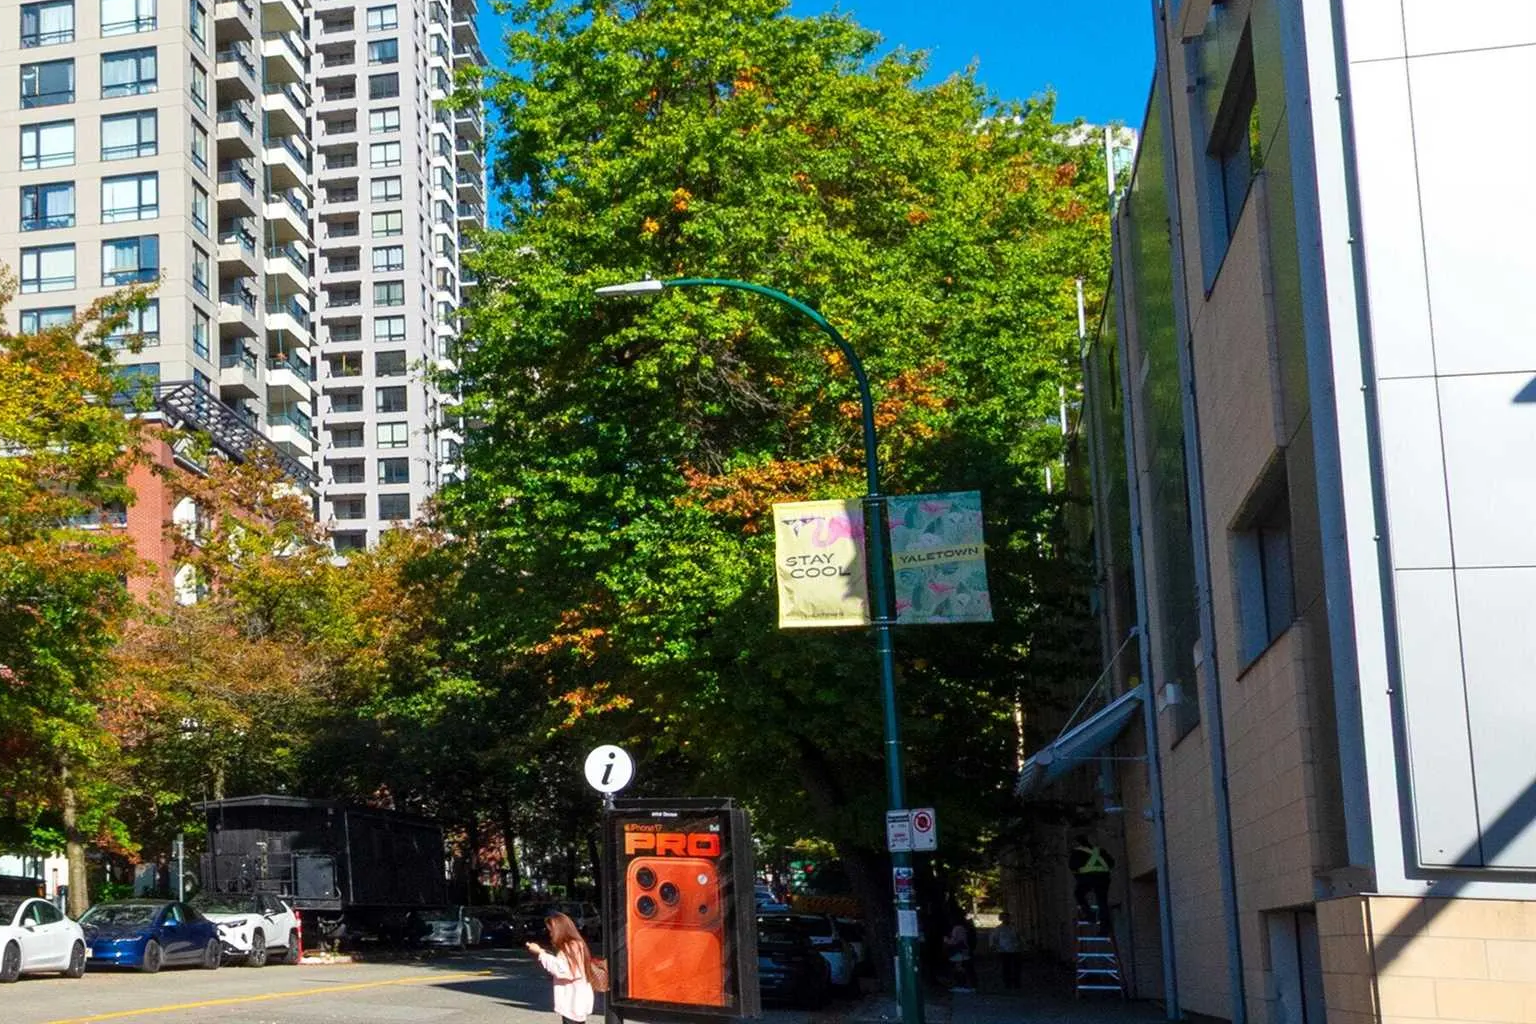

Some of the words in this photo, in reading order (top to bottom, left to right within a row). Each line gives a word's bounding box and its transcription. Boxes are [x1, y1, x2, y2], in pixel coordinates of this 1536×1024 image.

[785, 552, 835, 568] STAY
[898, 546, 979, 564] YALETOWN
[790, 565, 852, 580] COOL
[624, 832, 721, 857] PRO
